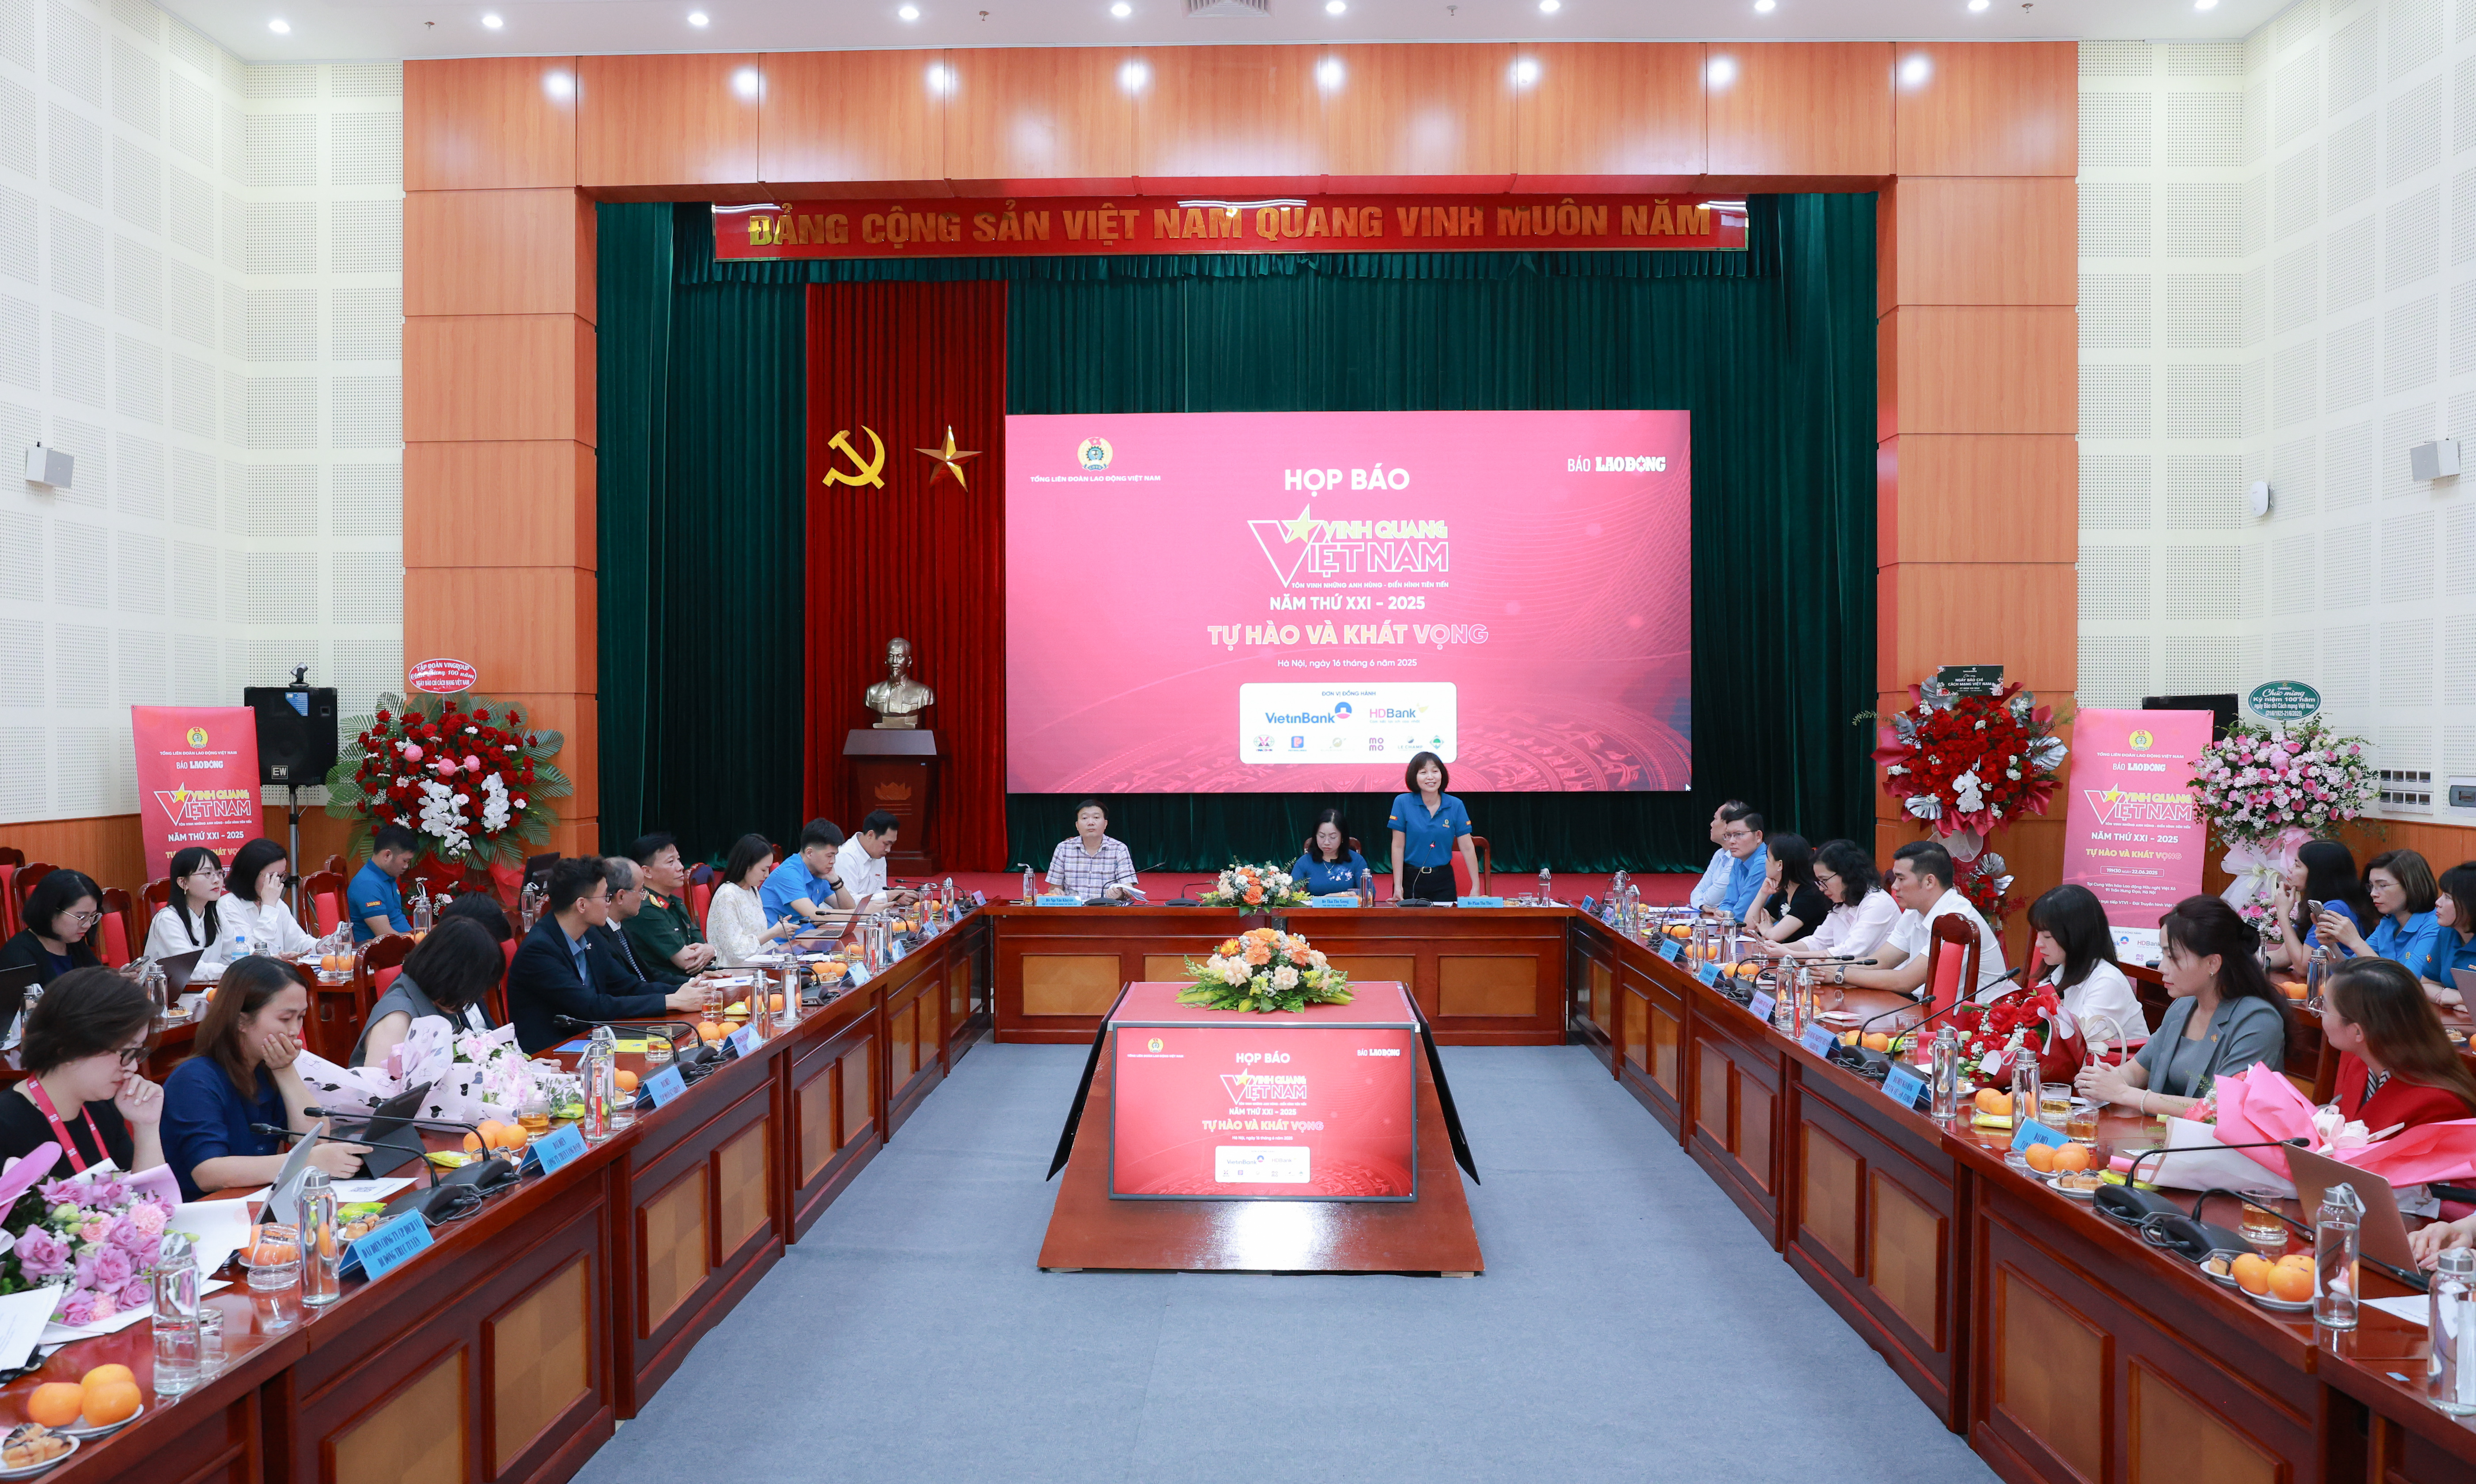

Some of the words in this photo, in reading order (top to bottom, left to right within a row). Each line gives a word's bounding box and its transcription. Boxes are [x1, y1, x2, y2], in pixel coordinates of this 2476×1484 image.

[749, 203, 848, 246] ĐẢNG
[861, 206, 961, 249] CỘNG
[973, 200, 1049, 242] SẢN
[1064, 203, 1140, 245] VIỆT
[1153, 208, 1242, 240] NAM
[1256, 206, 1383, 242] QUANG
[1397, 206, 1483, 236] VINH
[1497, 198, 1608, 236] MUÔN
[1621, 199, 1709, 235] NĂM
[1568, 455, 1590, 472] BÁO
[1285, 468, 1343, 497] HỌP
[1352, 463, 1409, 490] BÁO
[1323, 520, 1372, 539] VINH
[1375, 519, 1448, 539] QUANG
[1368, 540, 1449, 572] NAM
[1270, 593, 1306, 610] NĂM
[1310, 593, 1343, 610] THỨ
[1346, 597, 1371, 610] XXI
[1388, 596, 1425, 609] 2025
[1208, 623, 1241, 651] TỰ
[1245, 620, 1300, 645] HÀO
[1305, 619, 1338, 645] VÀ
[1344, 619, 1408, 644] KHÁT
[1413, 623, 1489, 650] VỌNG
[428, 661, 443, 669] ĐOÀN
[444, 662, 470, 671] VINGROUP
[1291, 659, 1307, 668] Nội,
[1309, 660, 1331, 668] ngày
[1342, 659, 1368, 668] tháng
[2262, 689, 2283, 697] Chúc
[1265, 712, 1335, 724] VietinBank
[1370, 708, 1416, 718] HDBank
[176, 760, 188, 769] BÁO
[2113, 762, 2125, 770] BÁO
[273, 767, 287, 776] EW
[168, 832, 187, 842] NĂM
[188, 831, 205, 840] THỨ
[2091, 831, 2112, 840] NĂM
[2114, 832, 2132, 841] THỨ
[2157, 835, 2178, 843] 2025
[2086, 848, 2097, 857] TỰ
[2098, 848, 2117, 857] HÀO
[2119, 849, 2130, 857] VÀ
[2132, 850, 2154, 858] KHÁT
[2156, 852, 2182, 861] VỌNG
[1236, 1053, 1261, 1066] HỌP
[1265, 1050, 1290, 1063] BÁO
